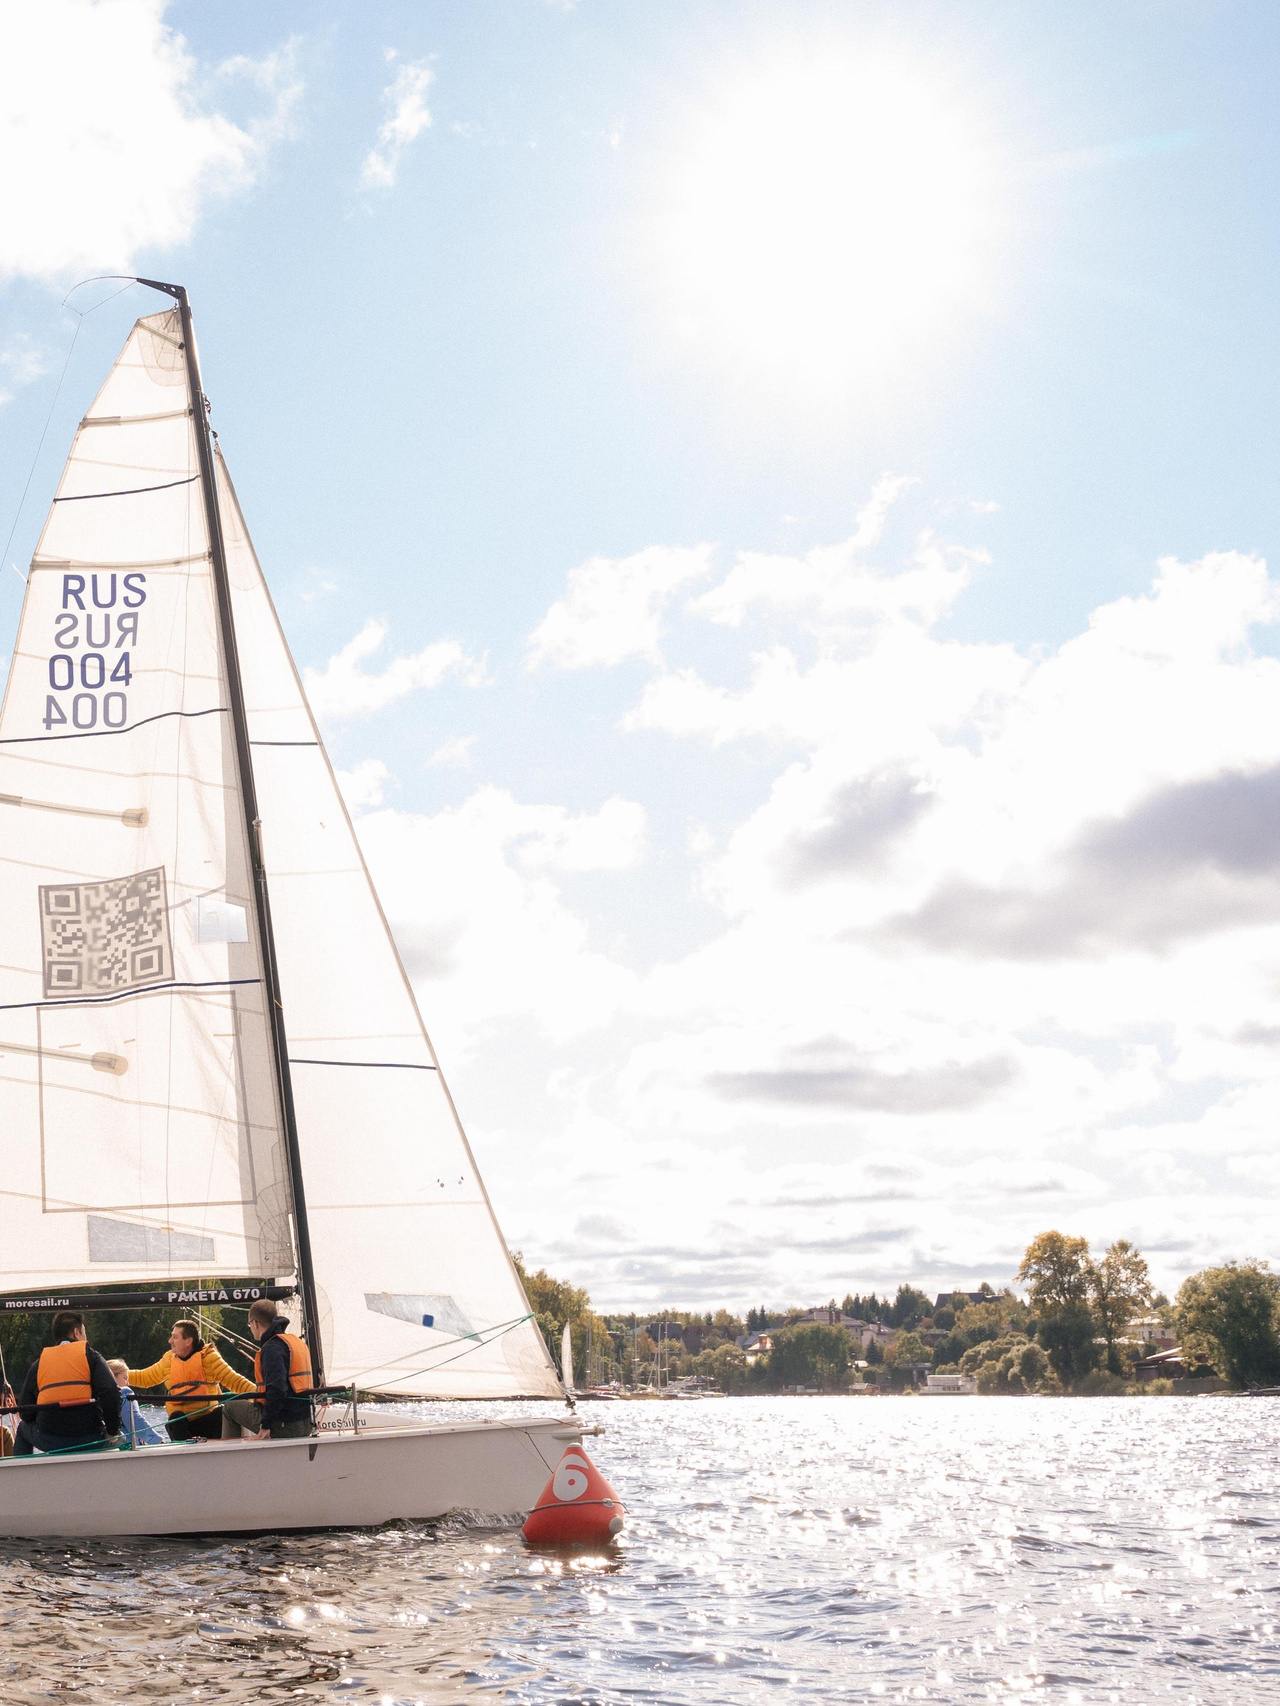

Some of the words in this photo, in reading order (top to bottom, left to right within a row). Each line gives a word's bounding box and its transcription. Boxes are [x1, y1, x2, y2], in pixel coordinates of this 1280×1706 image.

[62, 573, 147, 611] RUS
[48, 651, 133, 691] 004
[5, 1298, 70, 1308] moresail.ru
[167, 1290, 229, 1303] PAKETA
[232, 1288, 260, 1300] 670
[552, 1453, 590, 1502] 6
